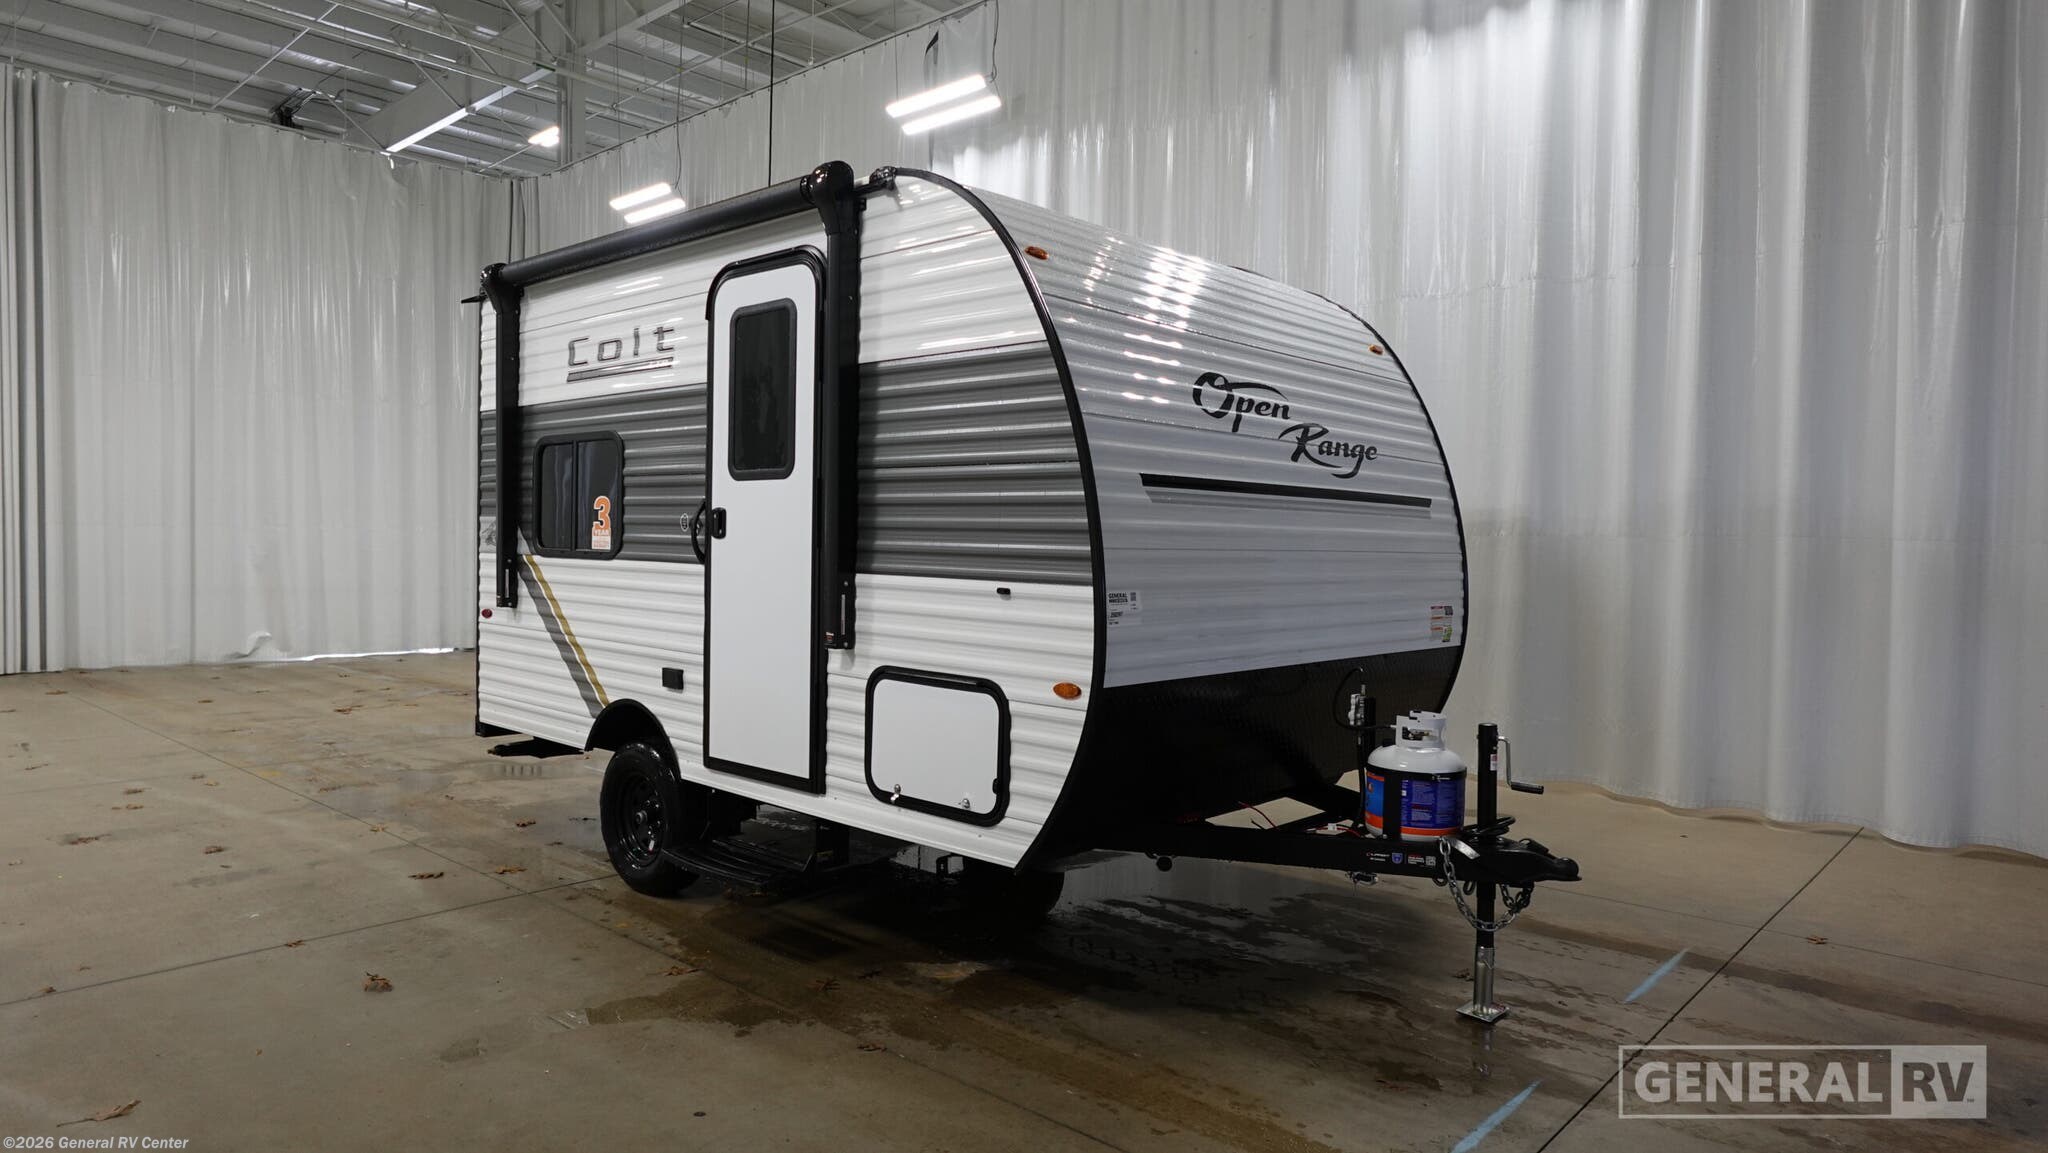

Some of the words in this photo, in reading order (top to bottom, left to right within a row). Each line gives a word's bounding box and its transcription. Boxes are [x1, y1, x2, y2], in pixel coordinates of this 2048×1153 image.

[568, 326, 675, 367] Colt
[1192, 371, 1291, 433] Open
[1278, 422, 1378, 479] Range
[593, 495, 611, 530] 3
